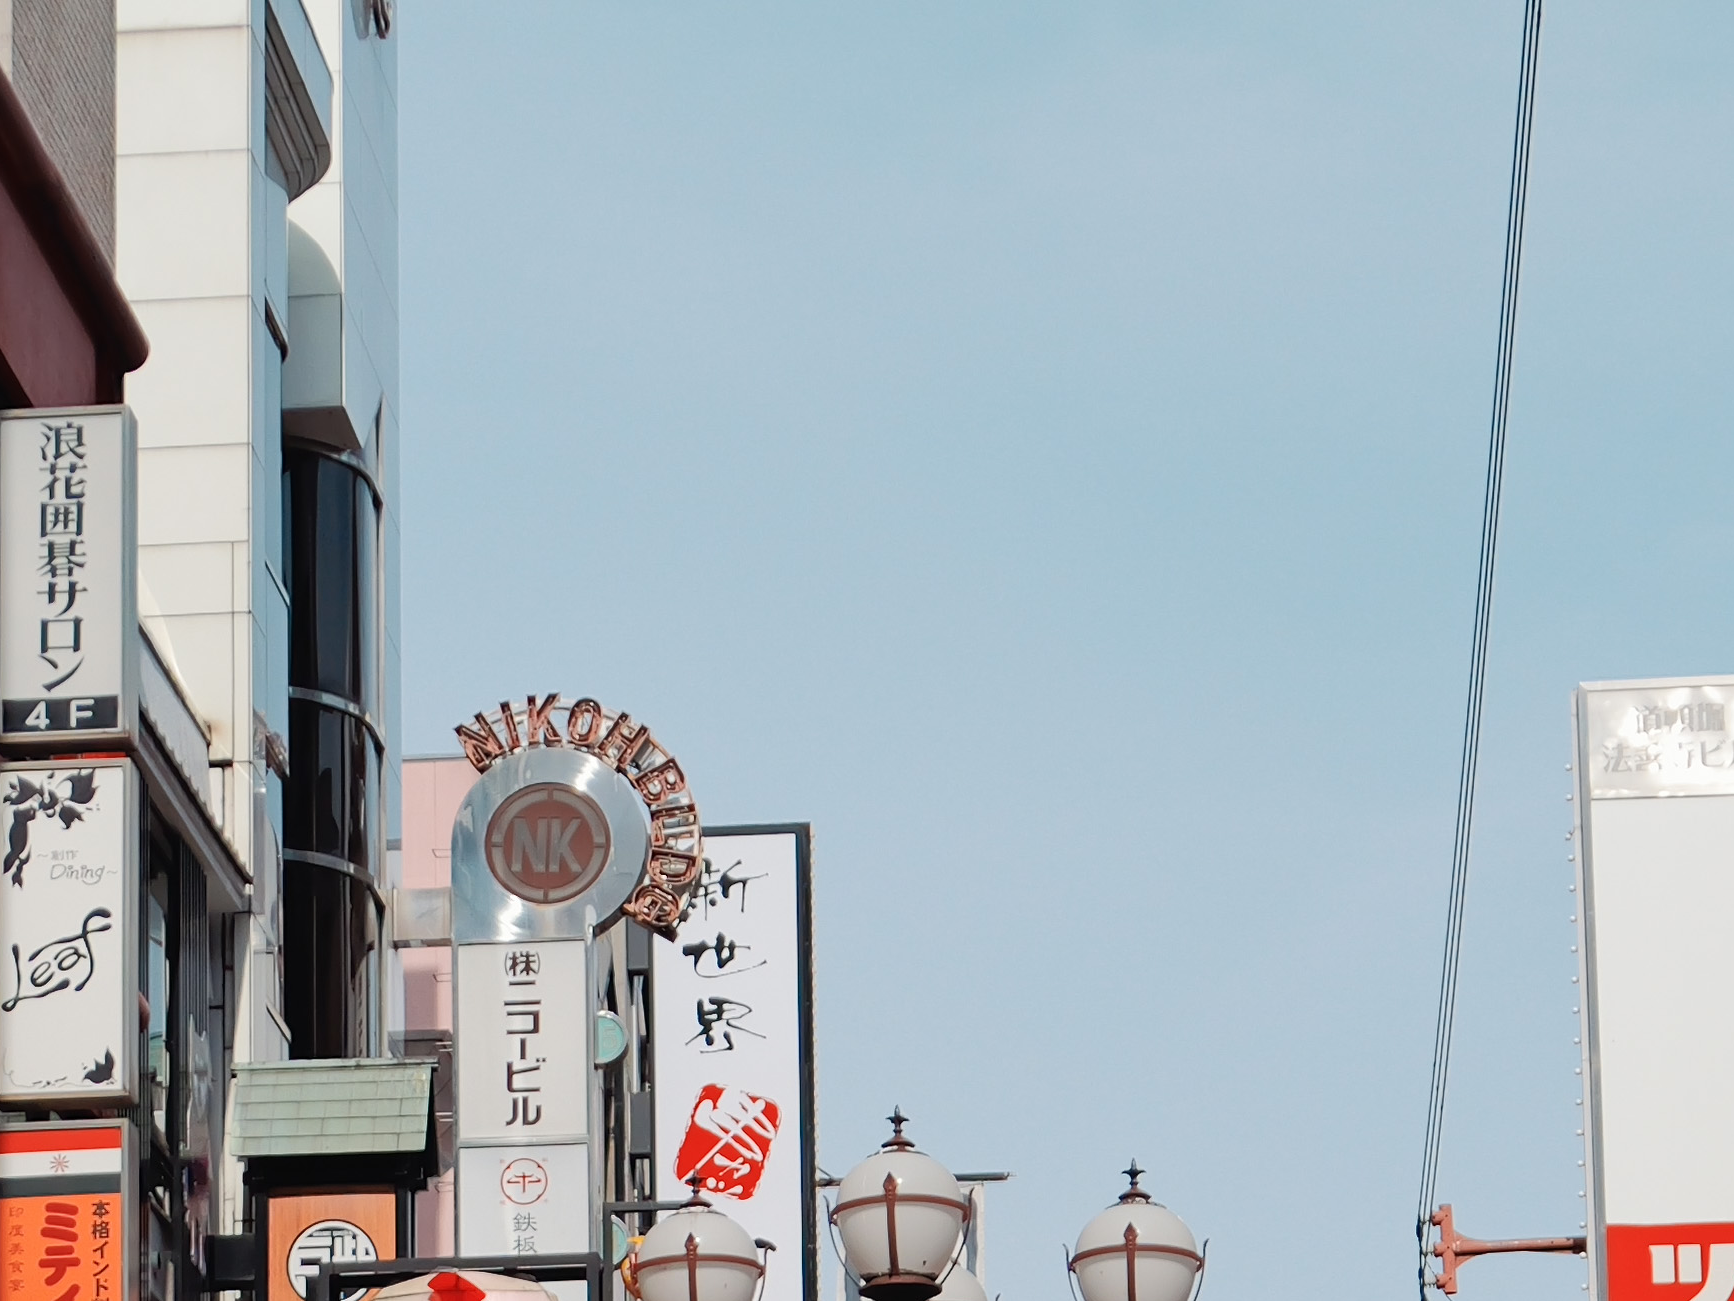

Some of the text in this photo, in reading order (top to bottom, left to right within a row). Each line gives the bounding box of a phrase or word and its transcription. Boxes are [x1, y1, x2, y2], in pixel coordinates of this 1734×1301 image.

[37, 421, 90, 694] 浪花囲碁サロン
[509, 815, 584, 875] NK
